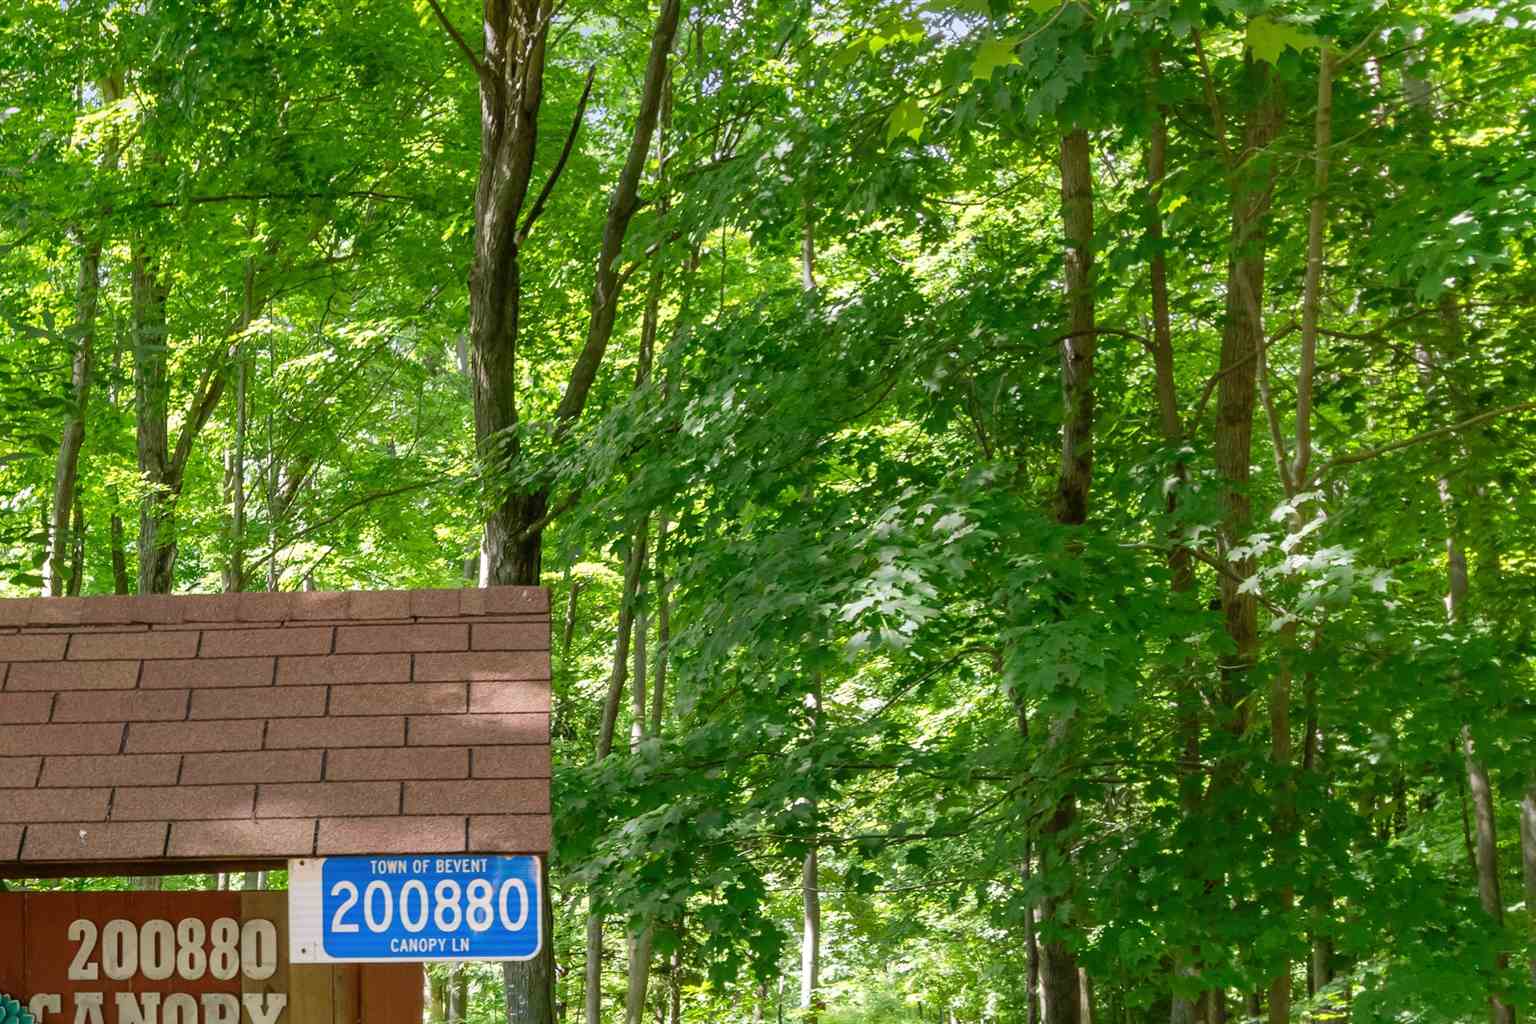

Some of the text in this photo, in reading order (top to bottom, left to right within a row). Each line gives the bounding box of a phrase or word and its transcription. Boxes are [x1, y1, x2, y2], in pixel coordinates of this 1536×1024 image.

[370, 858, 488, 874] TOWN OF BEVENT
[330, 878, 529, 933] 200880
[67, 917, 278, 981] 200880
[390, 937, 470, 953] CANOPY LN
